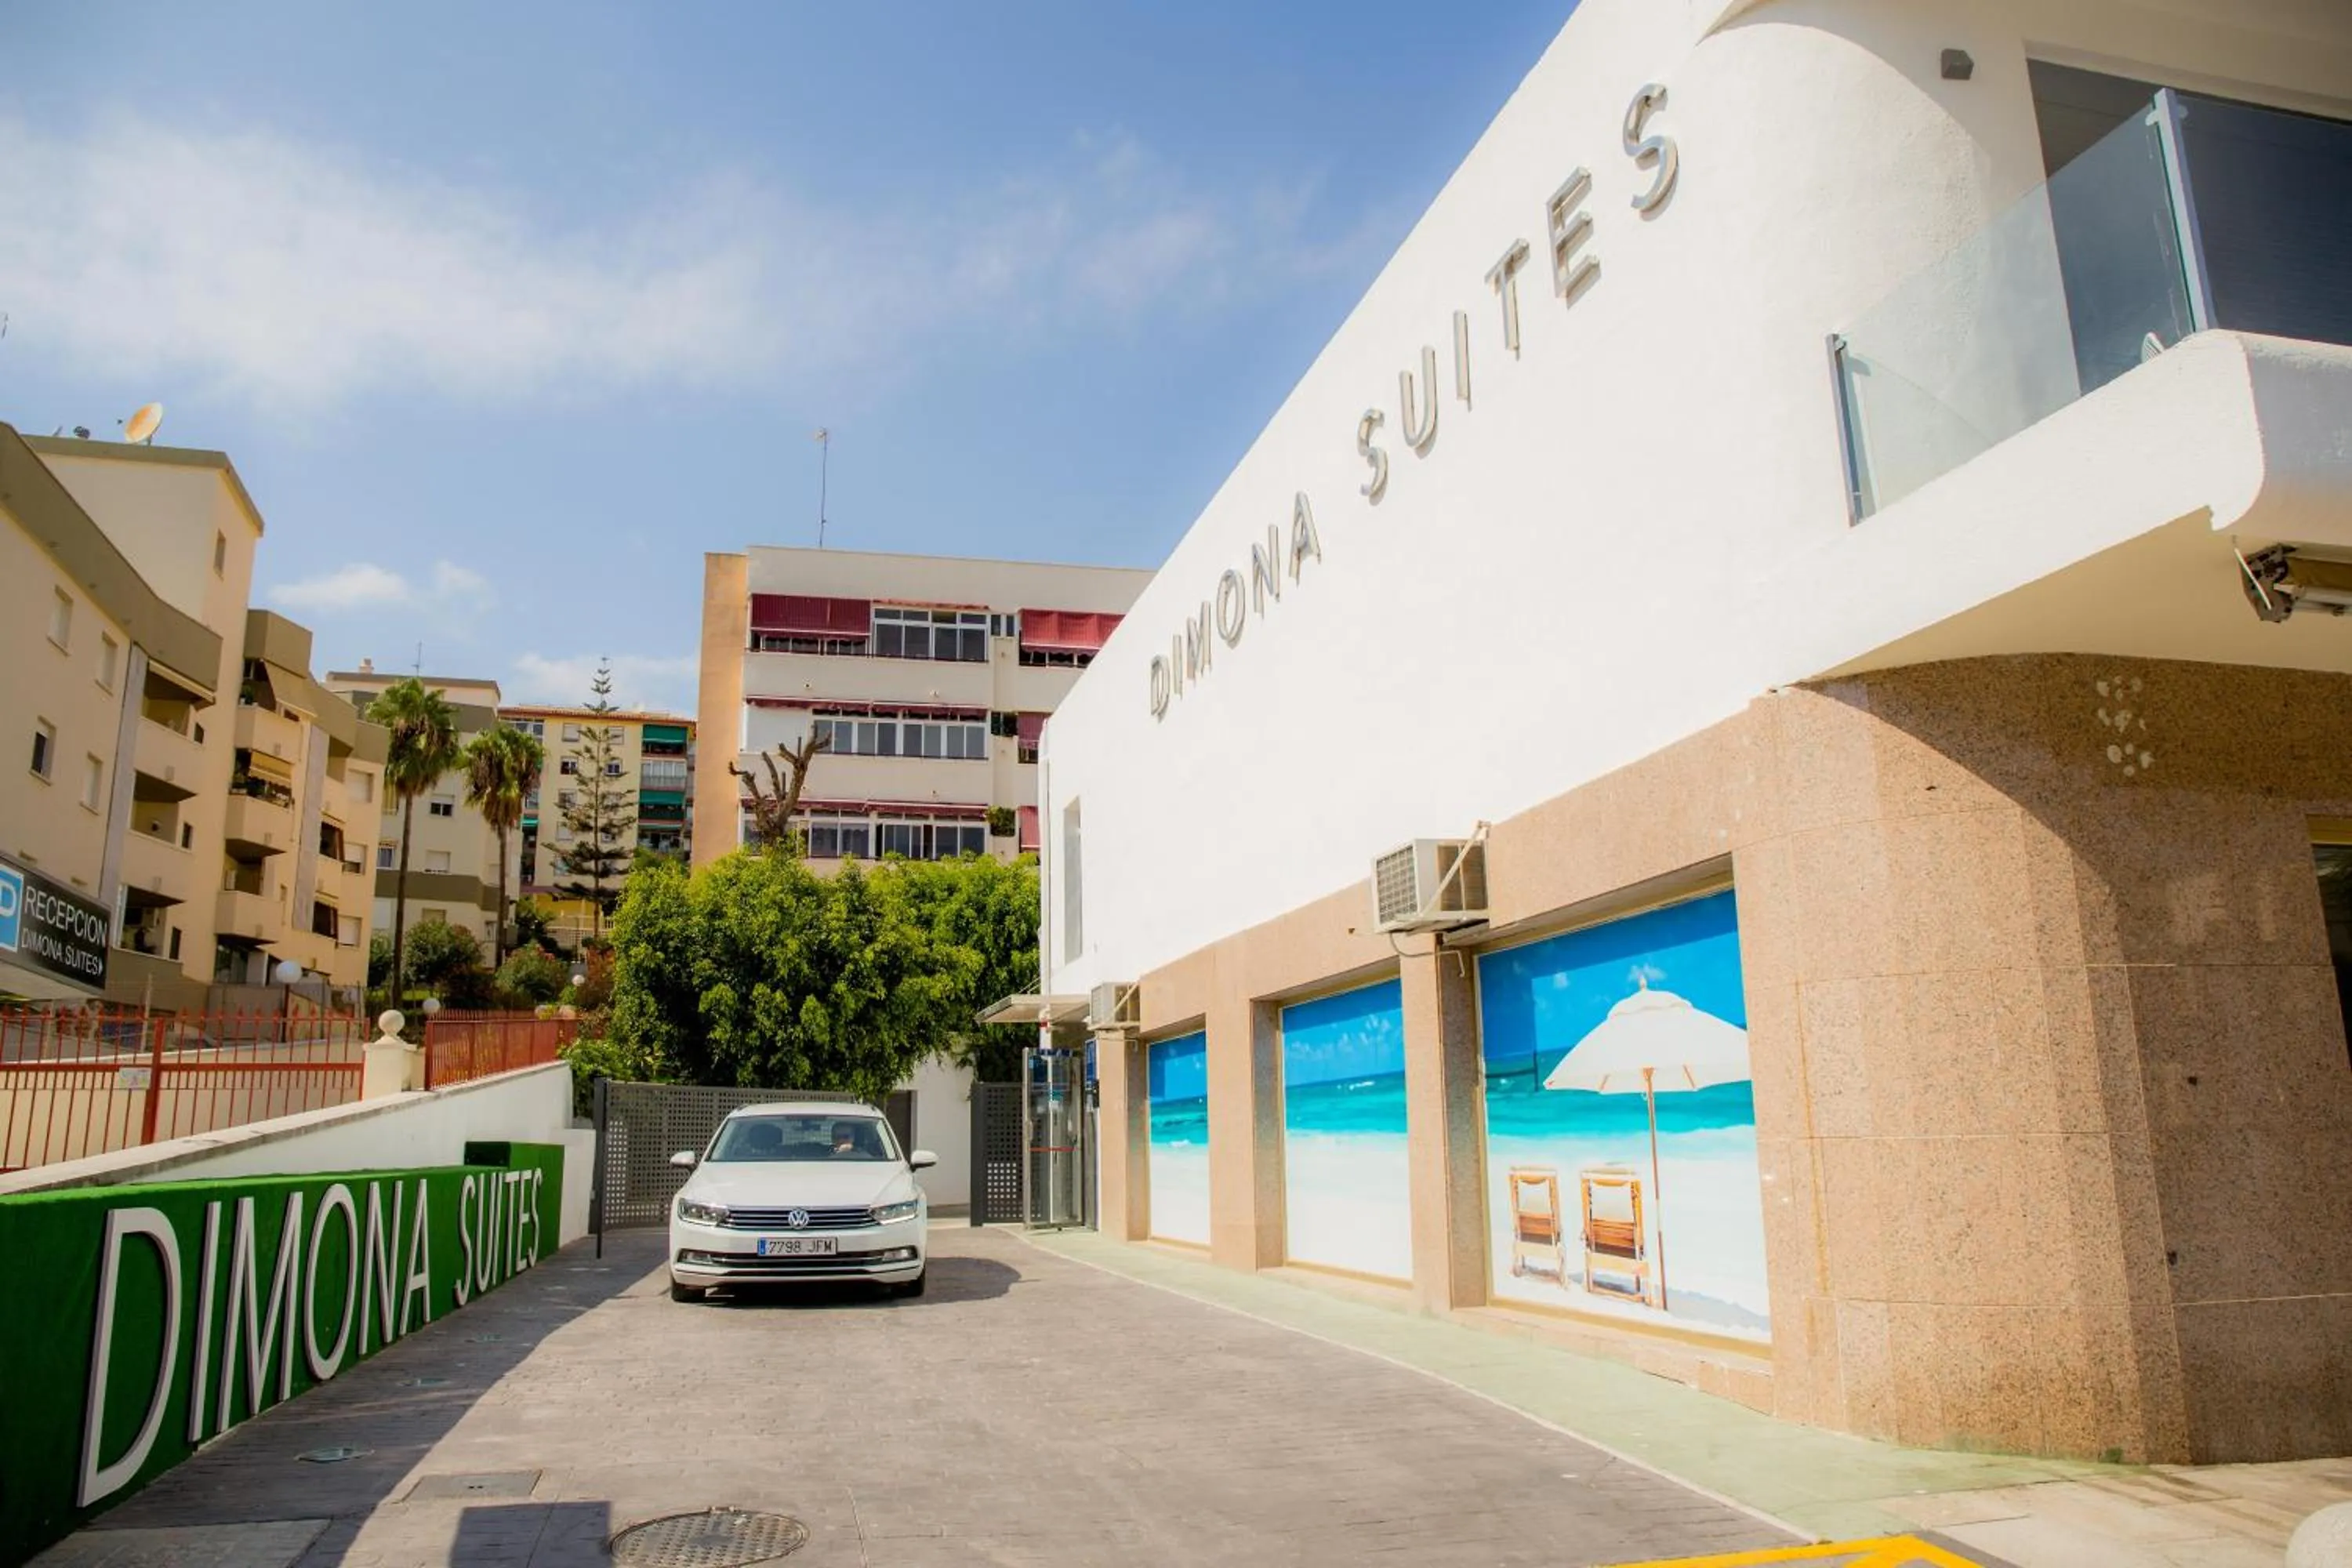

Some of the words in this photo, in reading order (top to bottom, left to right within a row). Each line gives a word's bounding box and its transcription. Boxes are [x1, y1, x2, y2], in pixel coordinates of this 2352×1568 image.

[1150, 490, 1322, 723] DIMONA
[1357, 82, 1679, 506] SUITES
[24, 885, 107, 948] RECEPCION
[21, 927, 63, 963] DIMONA
[65, 945, 99, 975] SUITES
[769, 1241, 800, 1253] 7798
[77, 1178, 432, 1508] DIMONA
[454, 1167, 543, 1307] SUITES
